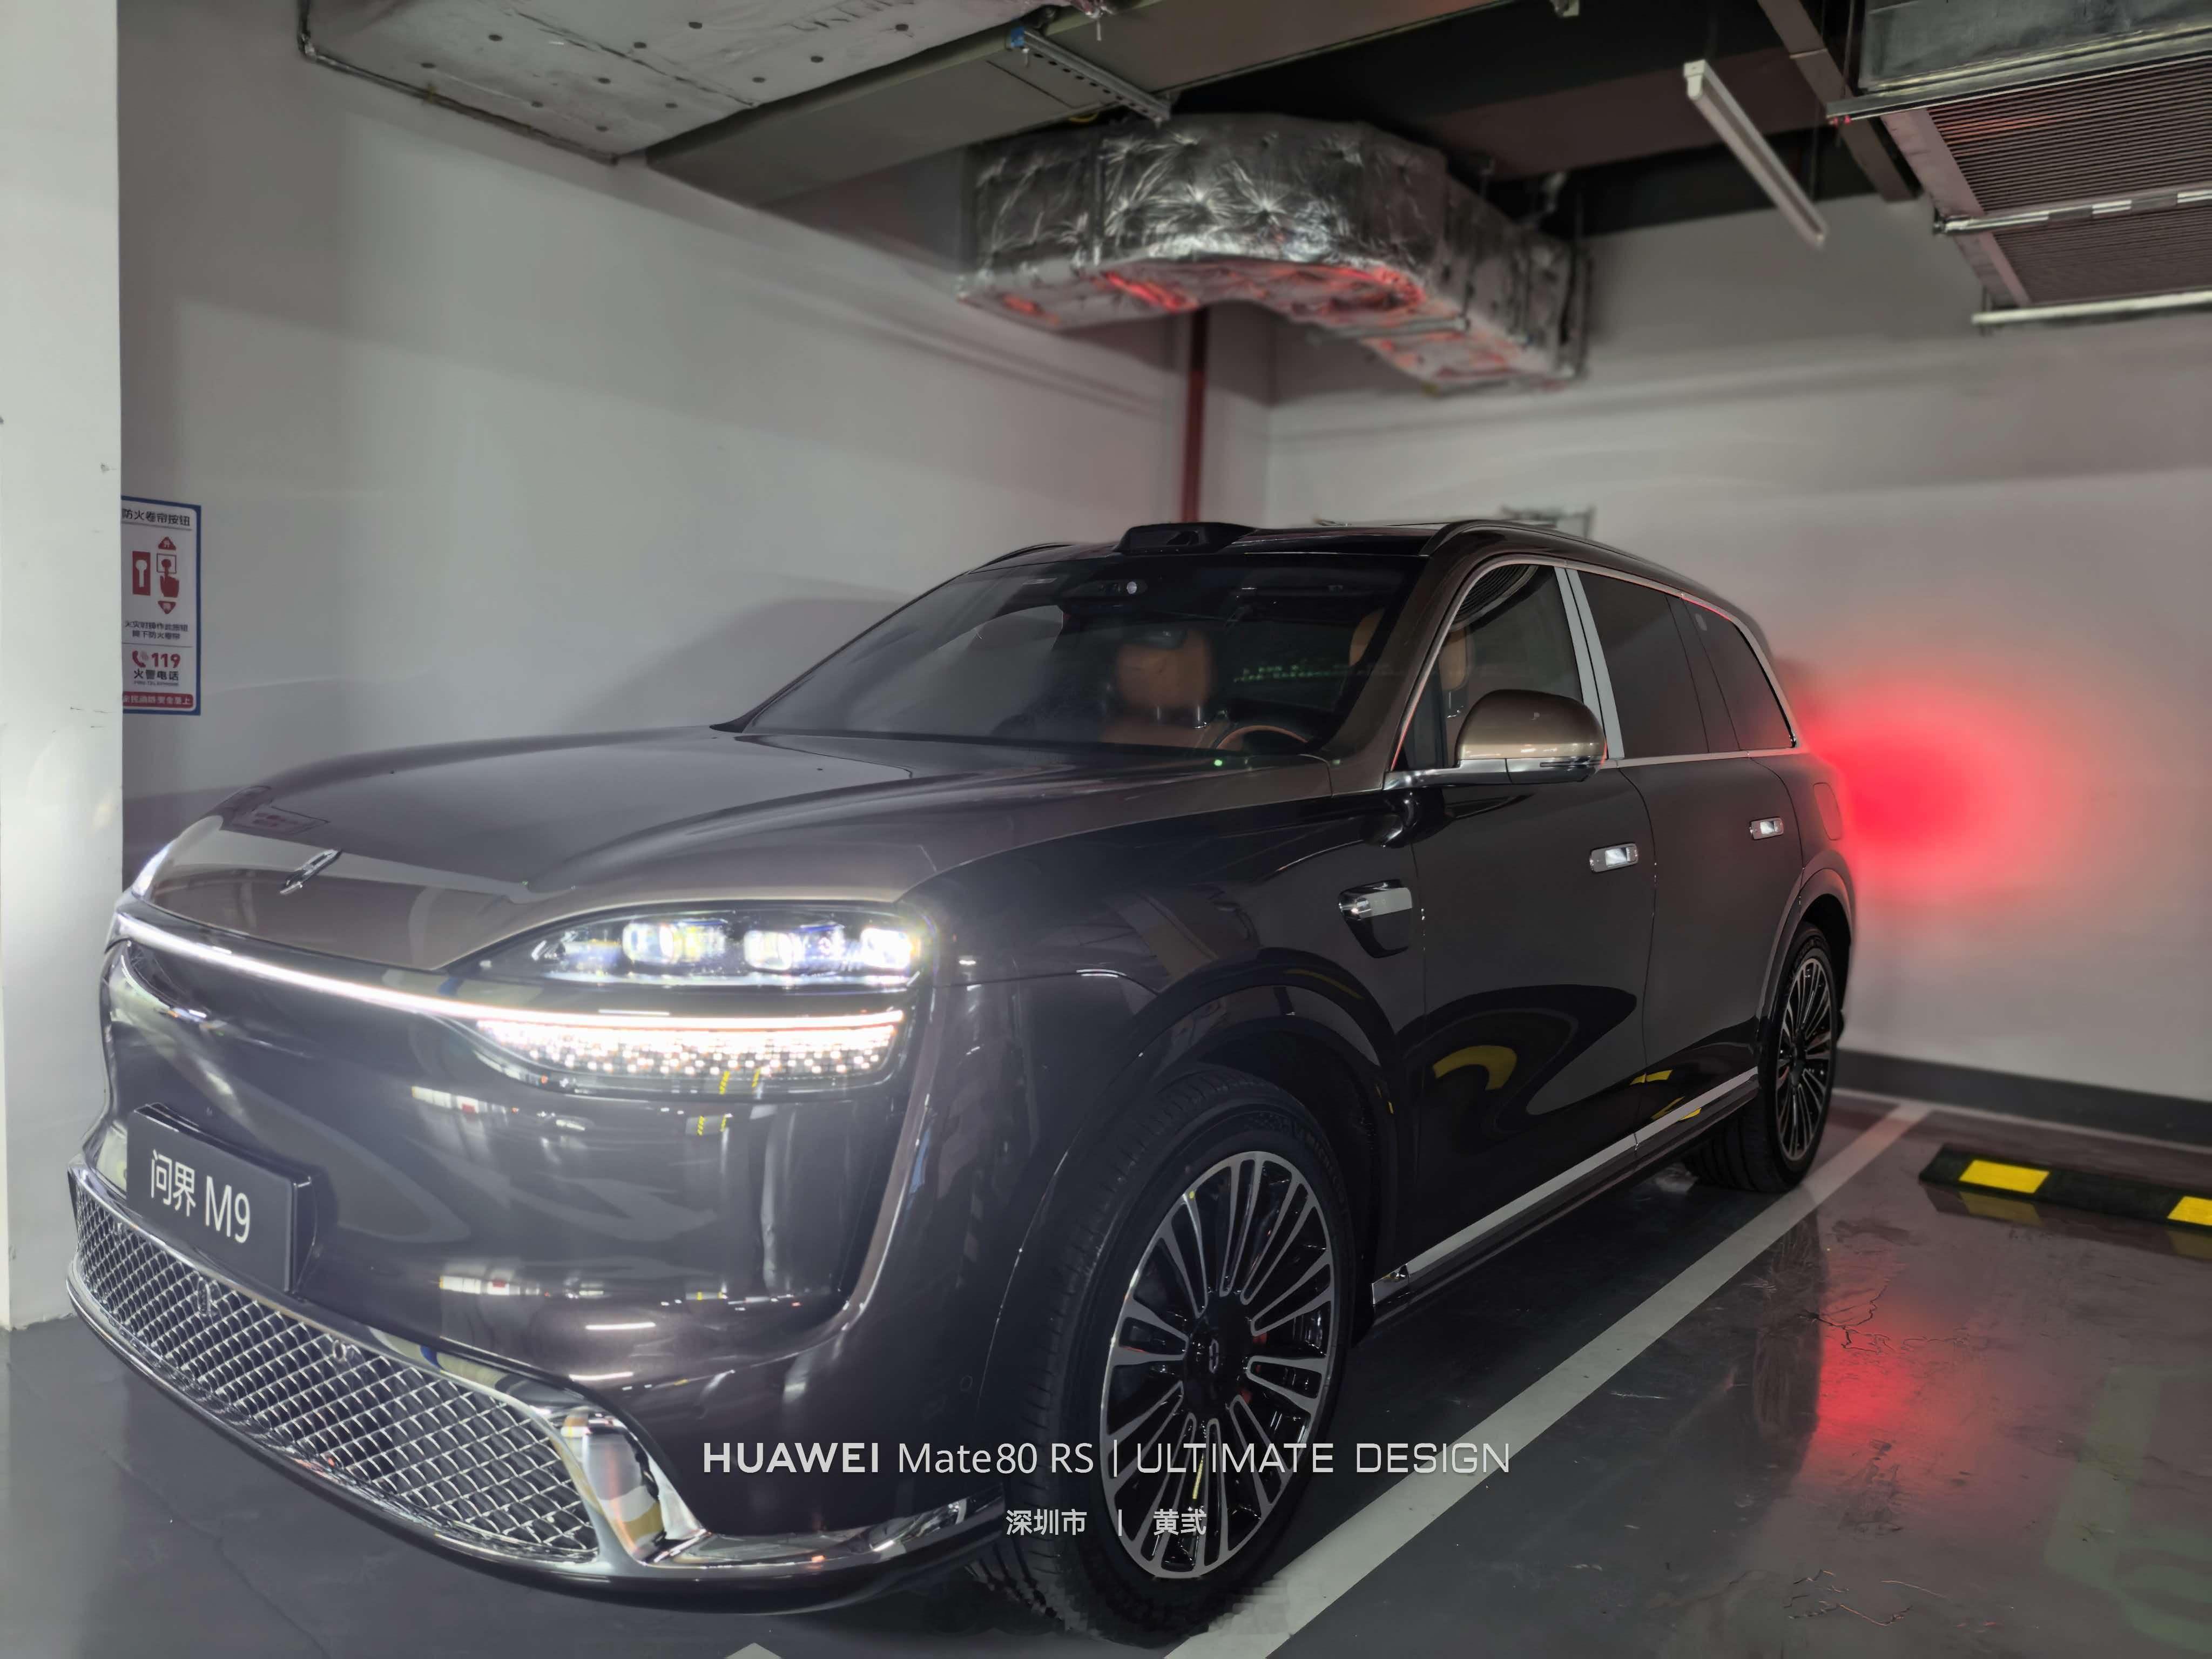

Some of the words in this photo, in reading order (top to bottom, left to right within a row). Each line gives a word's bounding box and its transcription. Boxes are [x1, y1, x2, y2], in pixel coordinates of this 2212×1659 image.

[151, 652, 180, 668] 119
[151, 1149, 196, 1217] 问界
[205, 1175, 251, 1244] M9
